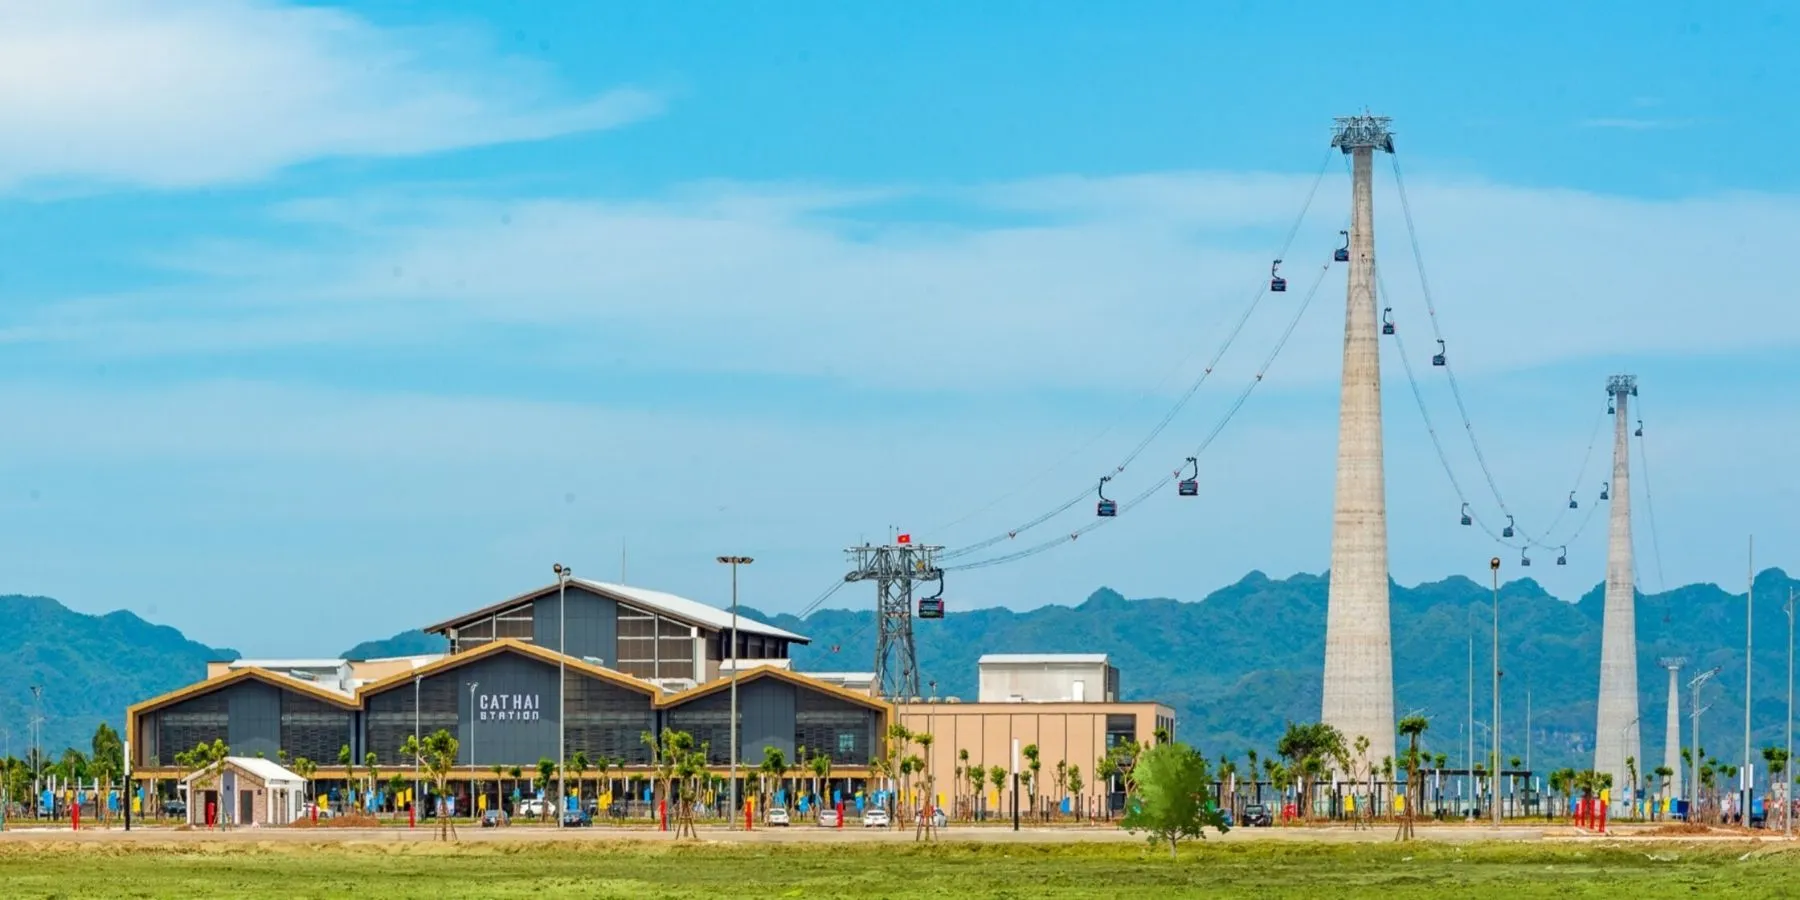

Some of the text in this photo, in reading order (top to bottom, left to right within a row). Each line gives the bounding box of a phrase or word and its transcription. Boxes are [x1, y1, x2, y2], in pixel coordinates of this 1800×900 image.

[480, 694, 539, 710] CAT HAI
[480, 711, 539, 720] STATION
